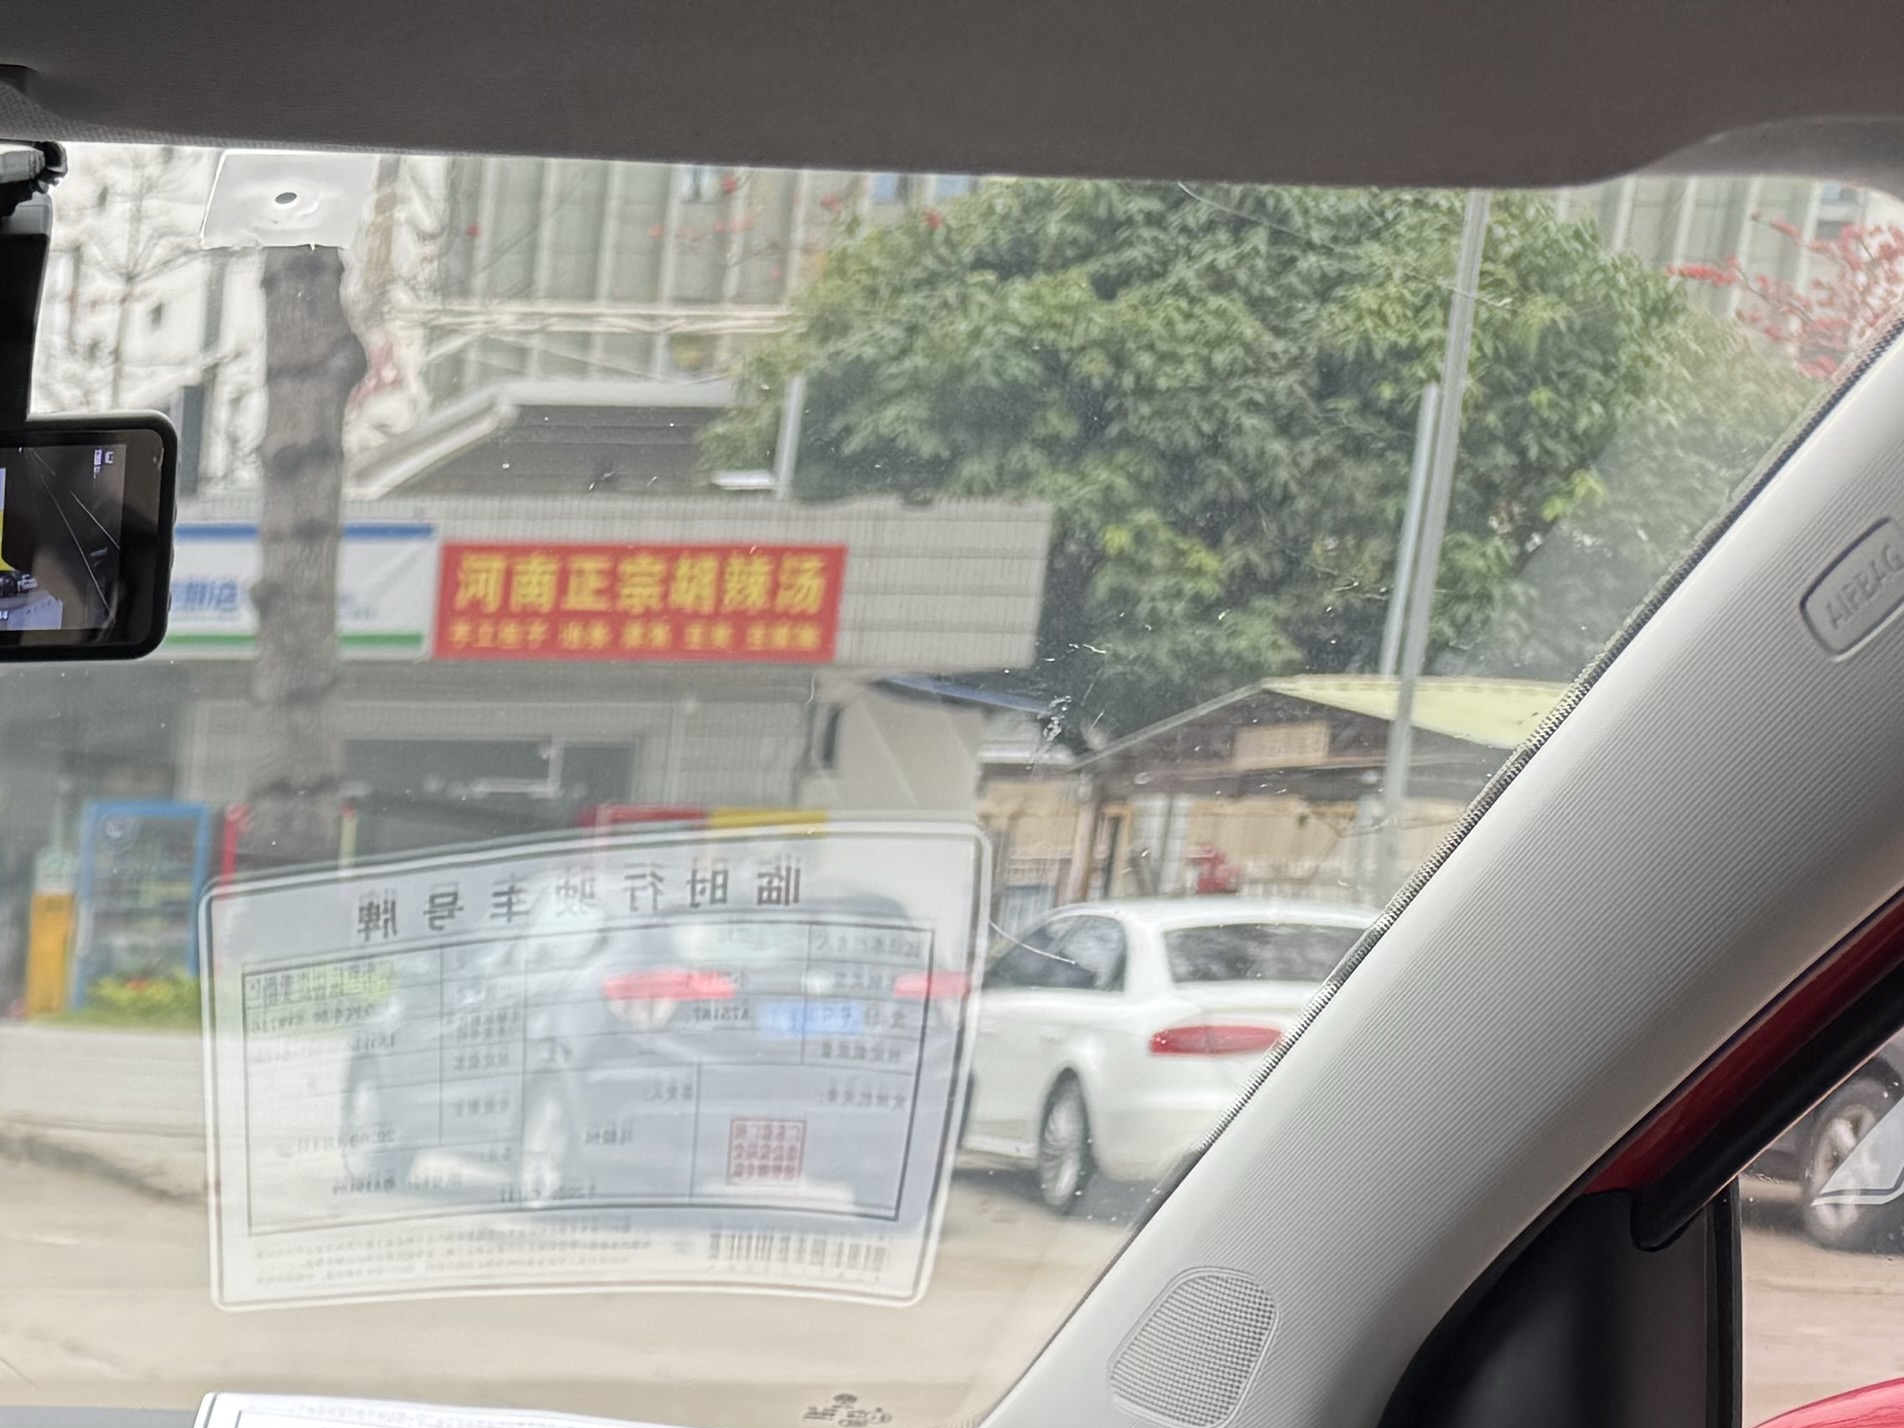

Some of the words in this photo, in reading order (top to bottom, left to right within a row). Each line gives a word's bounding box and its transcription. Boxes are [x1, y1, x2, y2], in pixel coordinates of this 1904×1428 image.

[456, 552, 827, 614] 河南正宗胡辣汤
